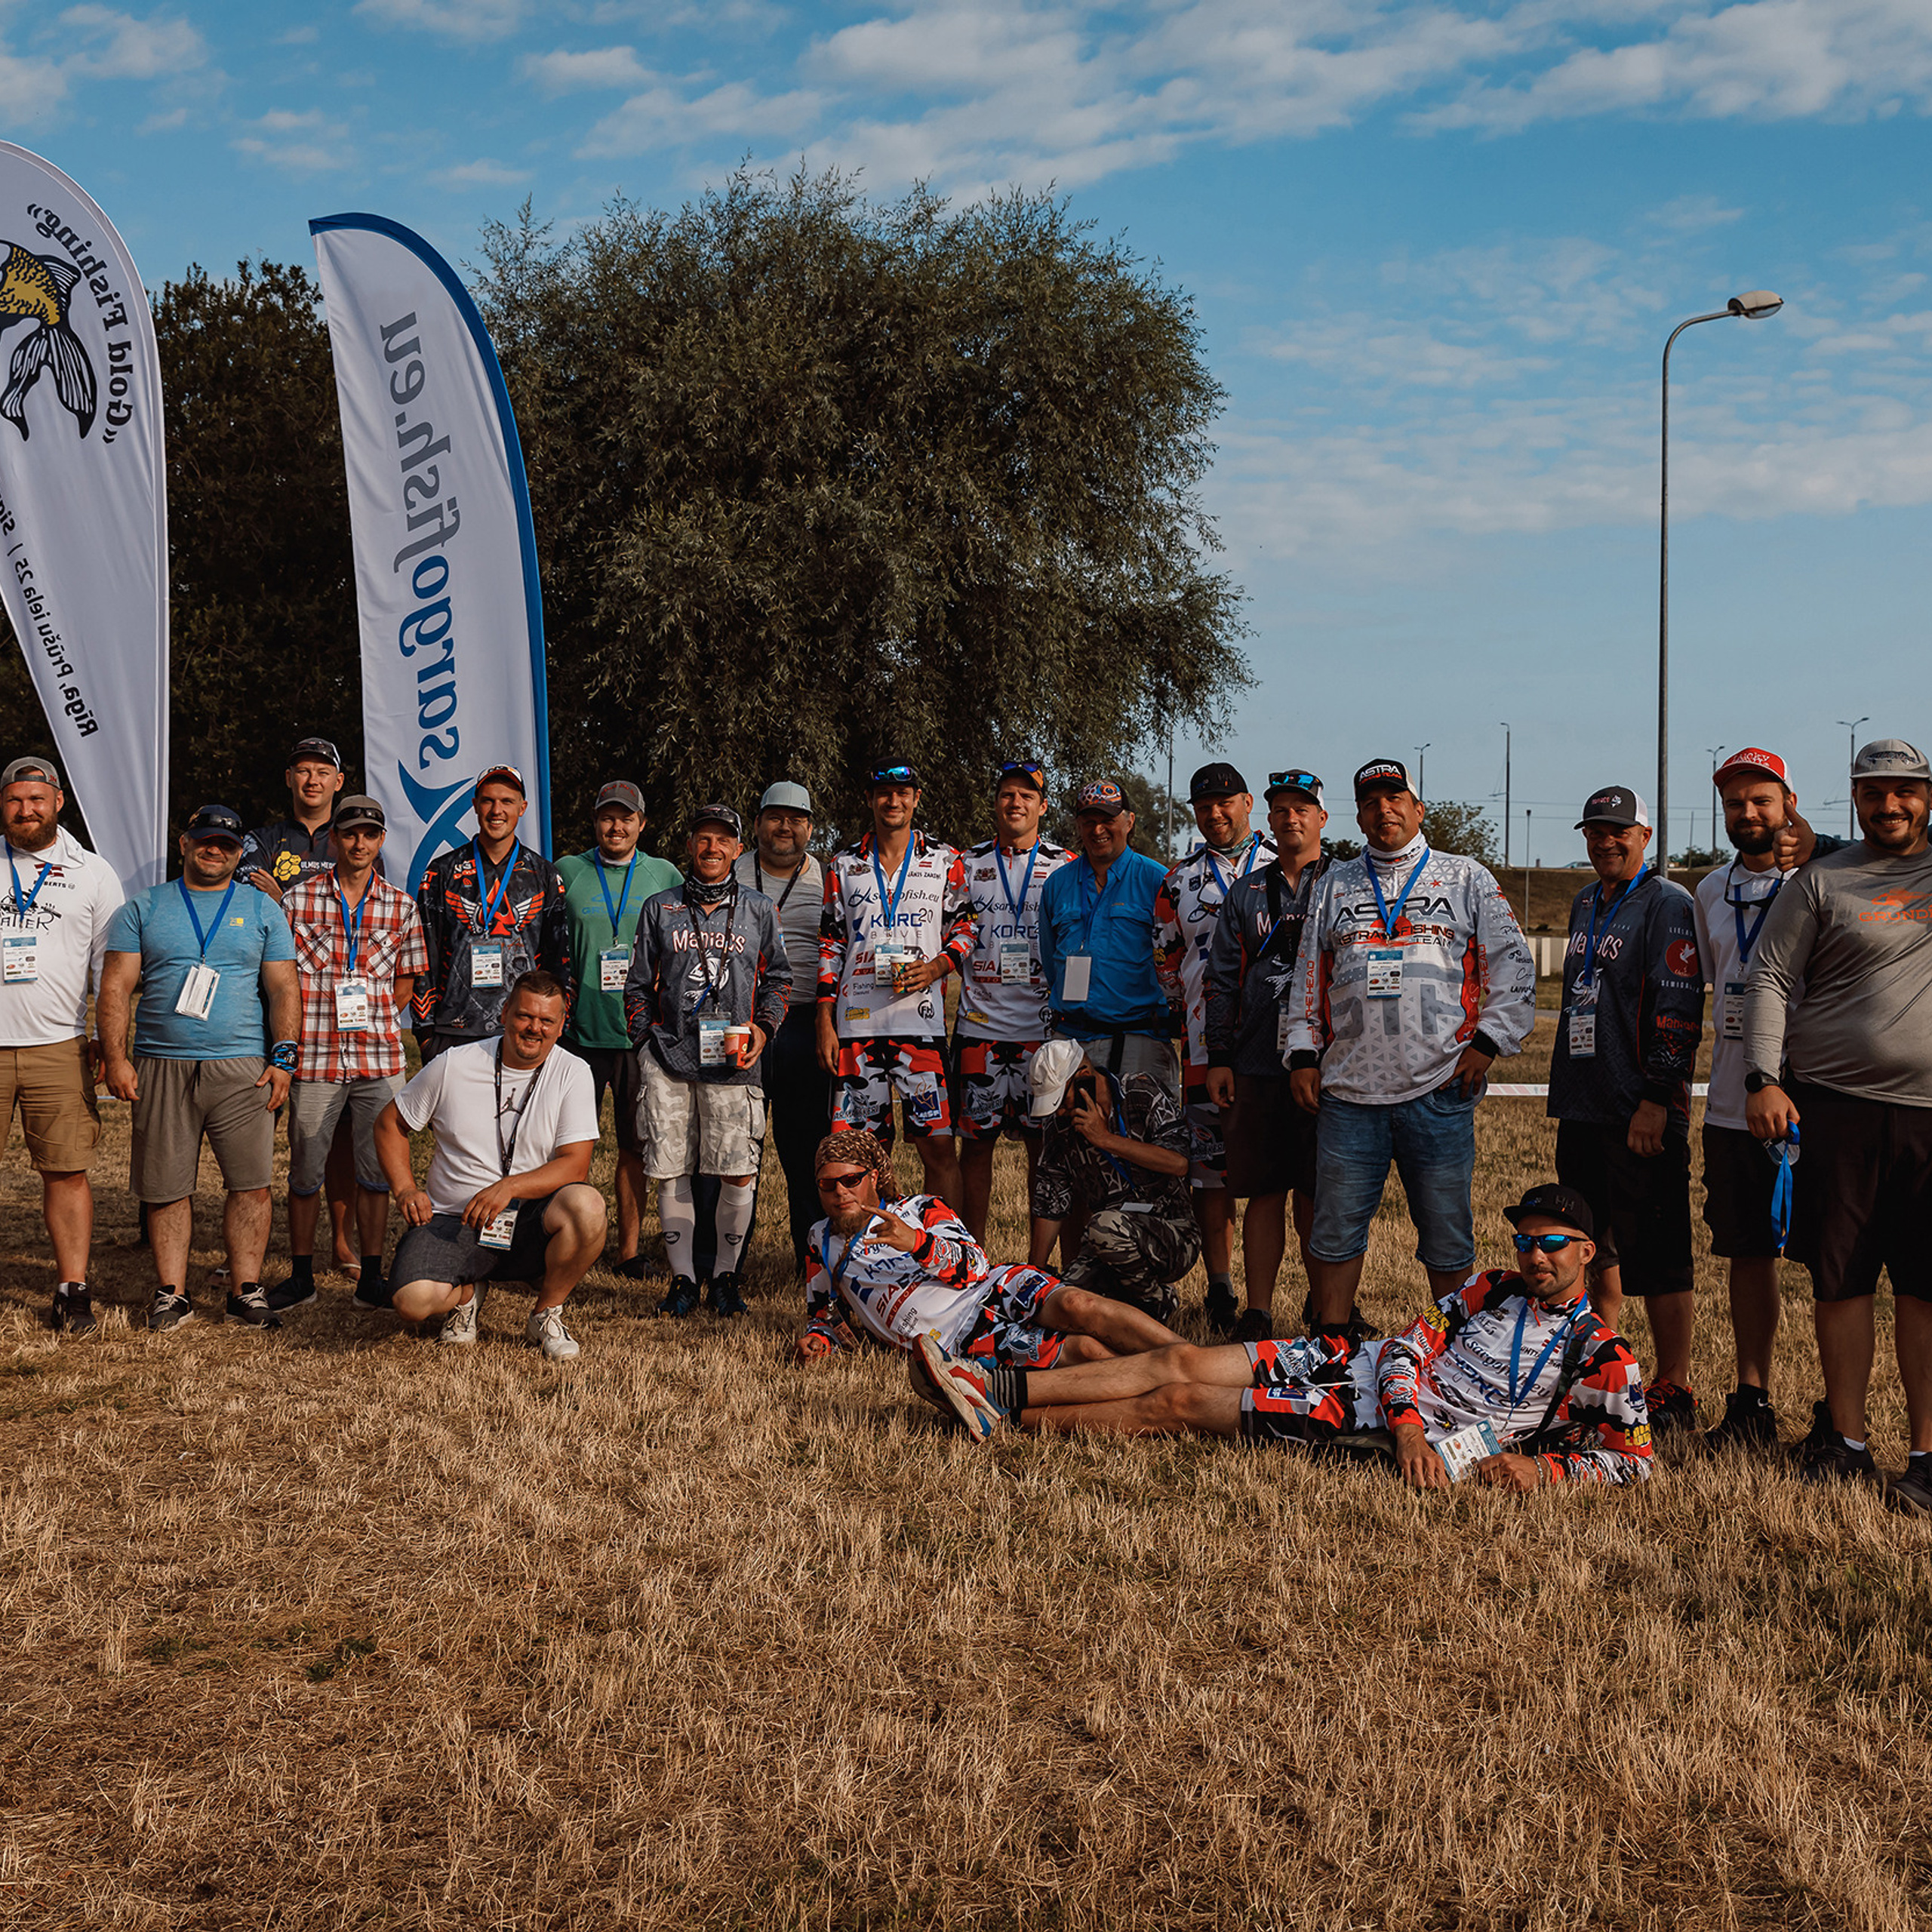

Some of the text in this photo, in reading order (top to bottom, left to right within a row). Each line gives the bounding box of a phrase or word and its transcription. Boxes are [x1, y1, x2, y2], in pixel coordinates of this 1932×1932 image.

[1359, 764, 1401, 782] ASTRA
[33, 880, 66, 888] BERTS
[1401, 924, 1455, 940] FISHING
[973, 960, 995, 972] SIA
